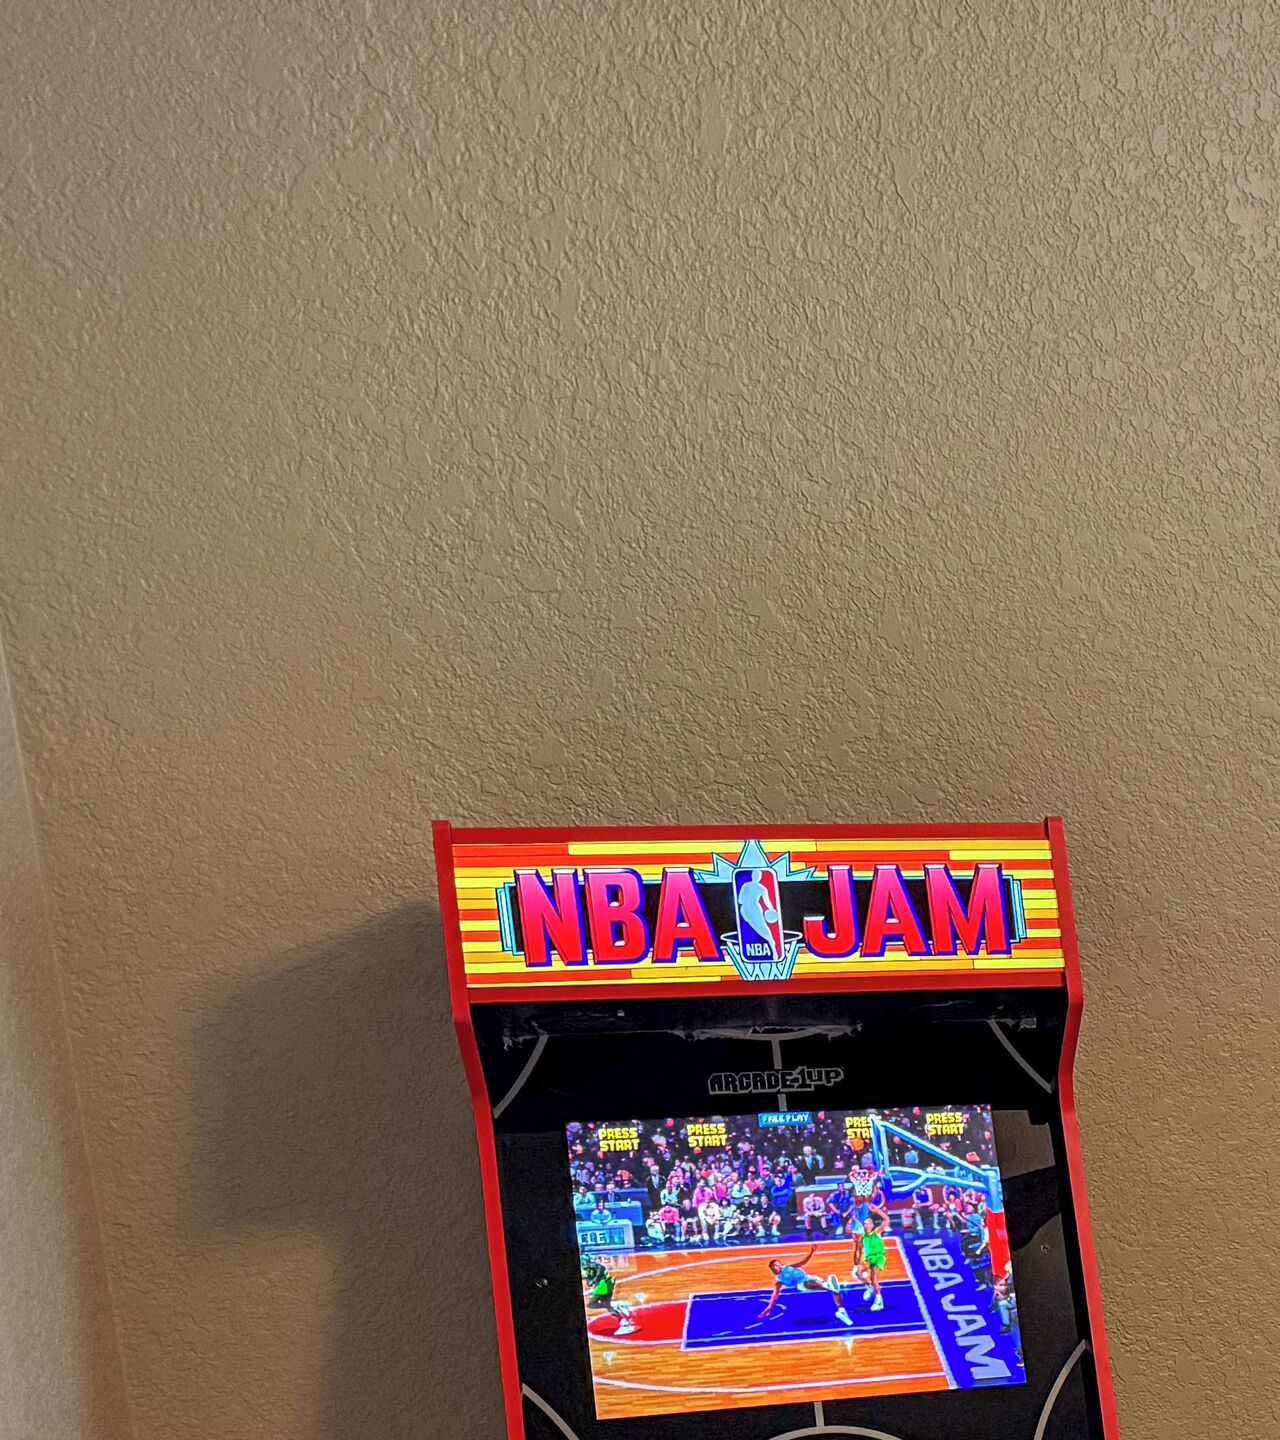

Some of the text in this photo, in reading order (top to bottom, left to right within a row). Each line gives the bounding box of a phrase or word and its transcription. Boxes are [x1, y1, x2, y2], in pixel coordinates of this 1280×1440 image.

[514, 862, 1016, 967] NBA JAM
[745, 943, 772, 957] NBA
[925, 1111, 963, 1124] PRESS
[598, 1127, 639, 1140] PRESS
[686, 1122, 726, 1135] PRESS
[927, 1122, 965, 1136] START
[600, 1138, 641, 1152] START
[688, 1133, 728, 1148] START
[913, 1238, 1012, 1380] NBA JAM
